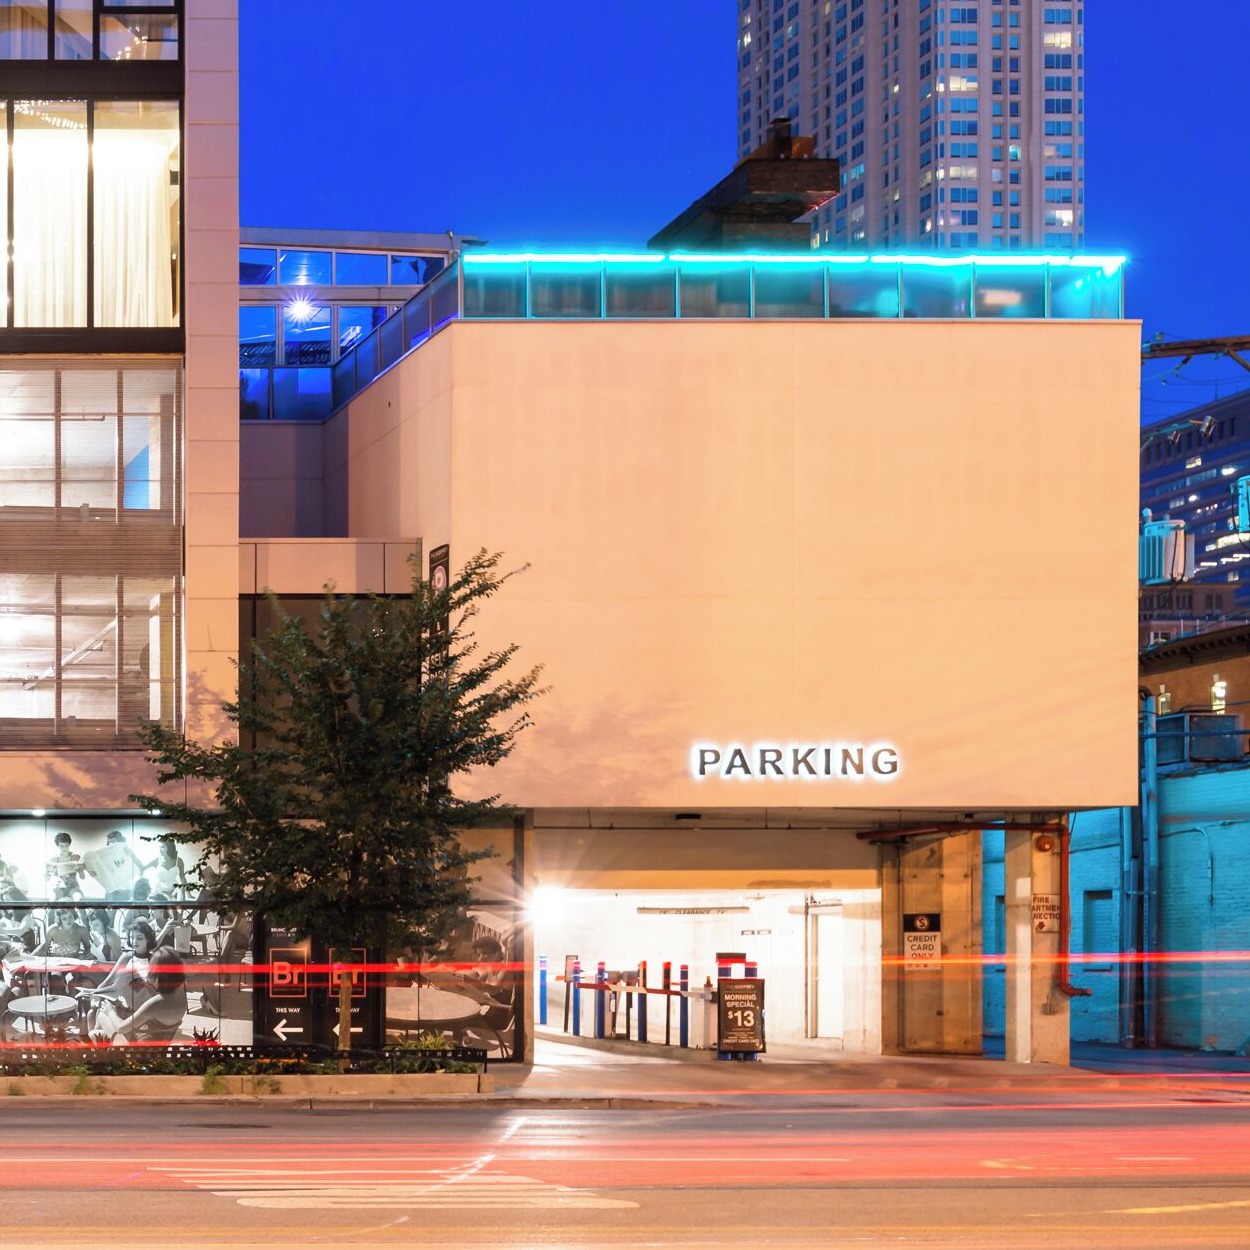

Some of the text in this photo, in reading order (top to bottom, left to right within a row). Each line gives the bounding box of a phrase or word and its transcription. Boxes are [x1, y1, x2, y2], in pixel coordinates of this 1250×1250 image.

[699, 748, 898, 776] PARKING
[1032, 896, 1050, 904] FIRE
[910, 943, 935, 951] CARD
[273, 961, 303, 985] Br
[728, 1010, 755, 1027] $13
